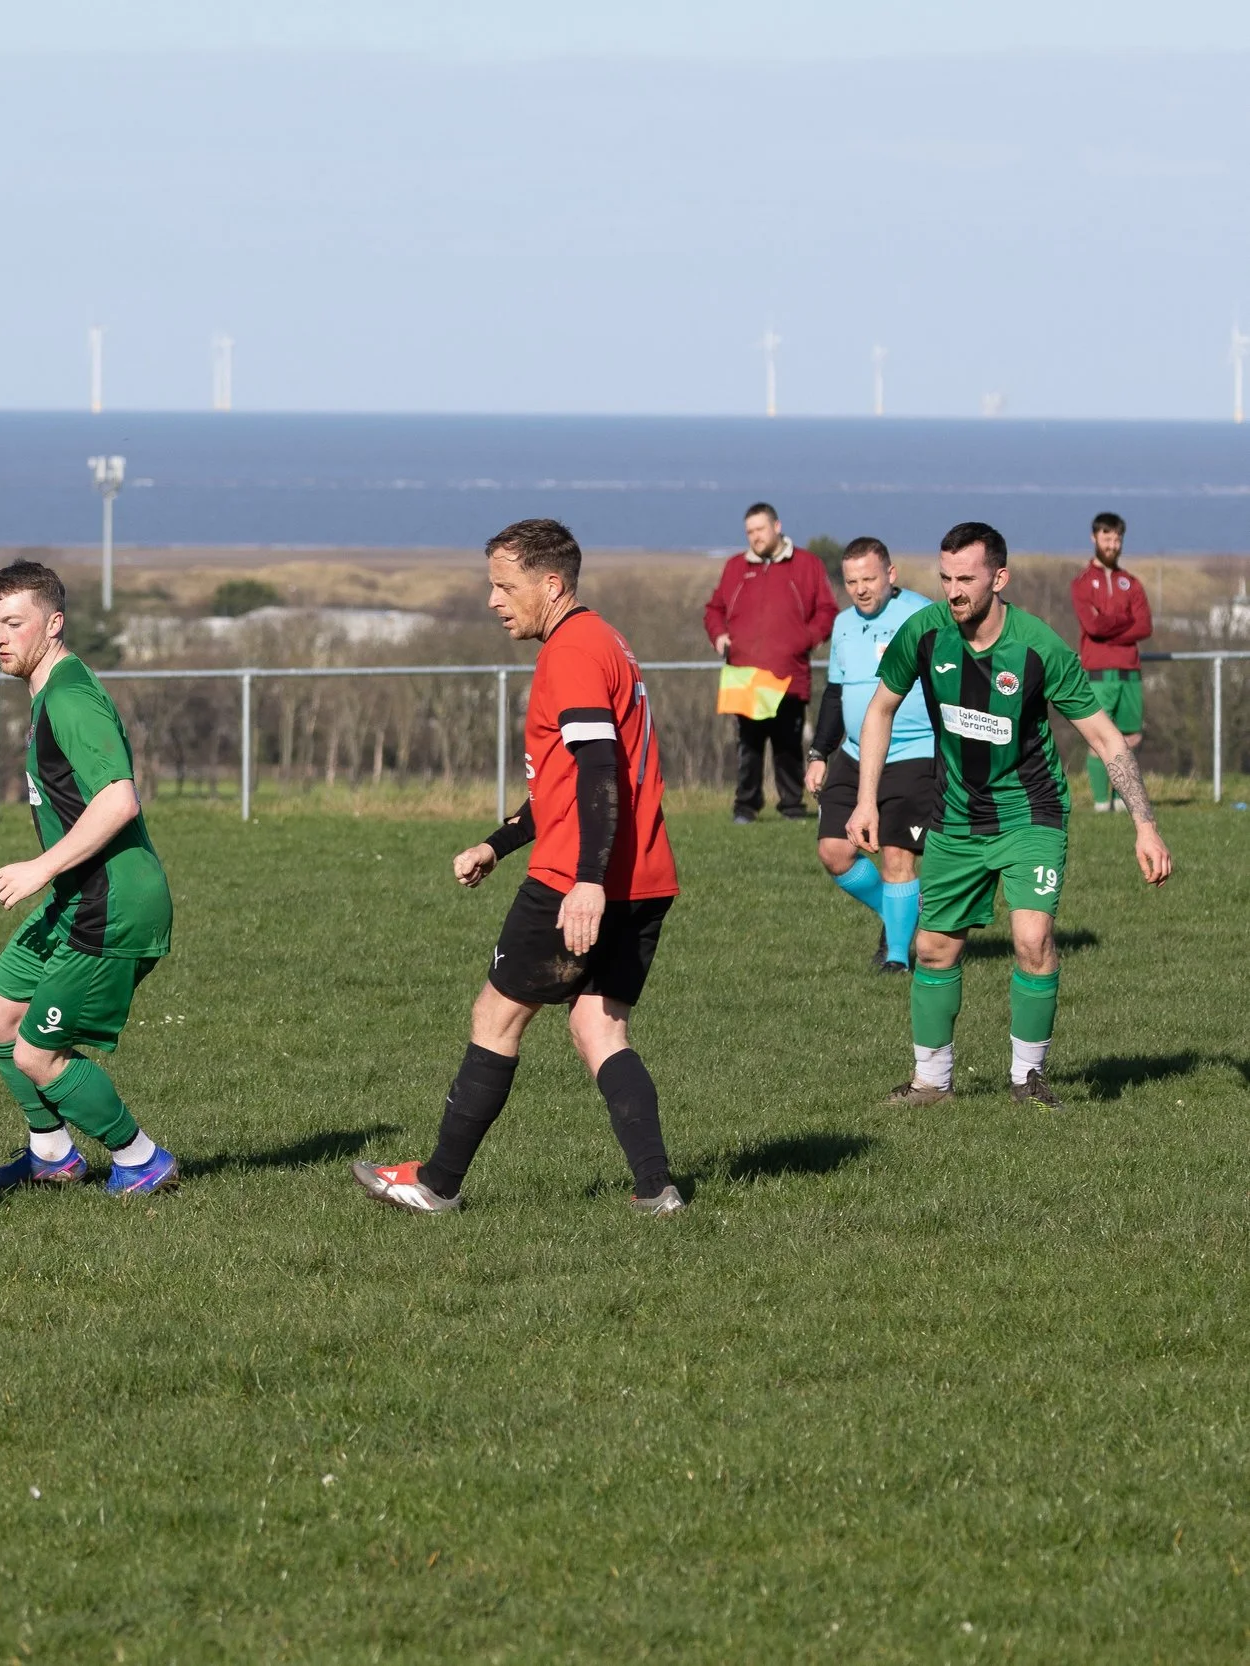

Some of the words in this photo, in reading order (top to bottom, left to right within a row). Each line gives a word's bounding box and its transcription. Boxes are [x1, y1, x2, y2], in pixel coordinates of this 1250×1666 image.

[959, 709, 999, 726] Lakeland
[959, 718, 1009, 735] Verandahs
[1033, 865, 1057, 887] 19
[46, 1006, 62, 1025] 9
